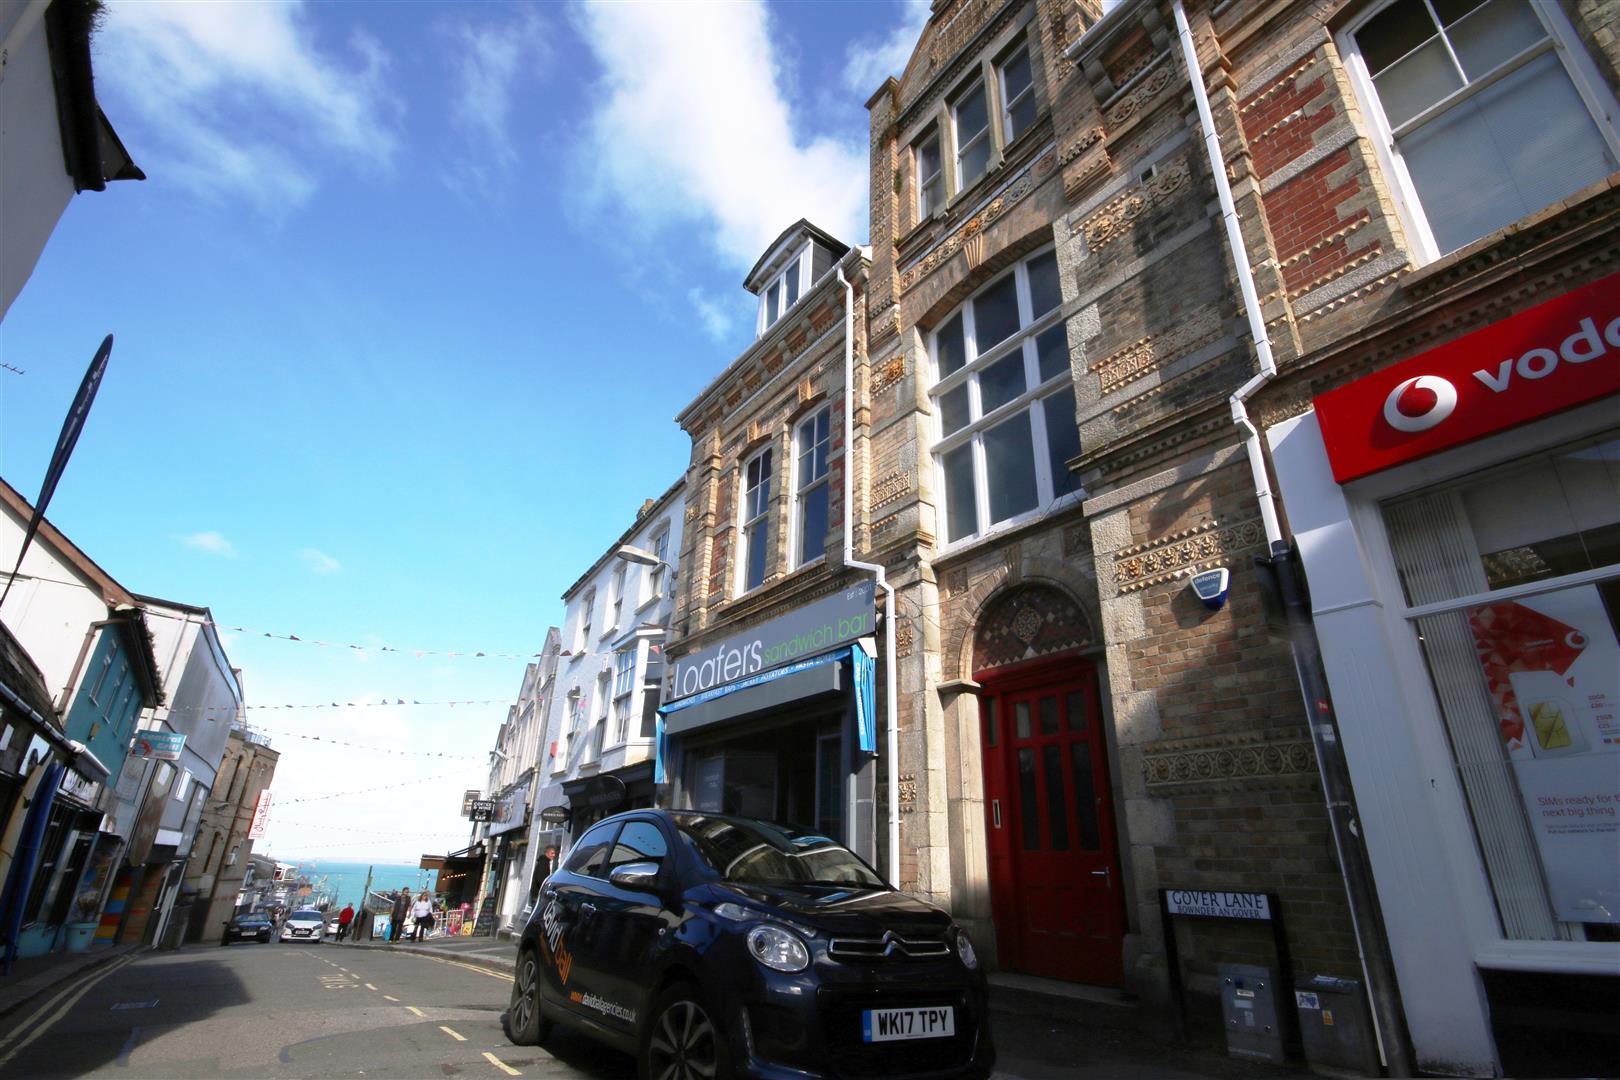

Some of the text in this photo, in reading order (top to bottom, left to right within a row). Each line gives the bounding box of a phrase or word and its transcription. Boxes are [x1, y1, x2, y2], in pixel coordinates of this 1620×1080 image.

[673, 612, 869, 699] Loafers sandwich bar
[1565, 795, 1594, 806] ready
[1542, 806, 1616, 818] next big thing
[1172, 891, 1264, 909] GOVER LANE
[1219, 907, 1232, 916] AN
[1232, 908, 1260, 918] GOVER
[878, 1009, 948, 1036] WK17 TPY
